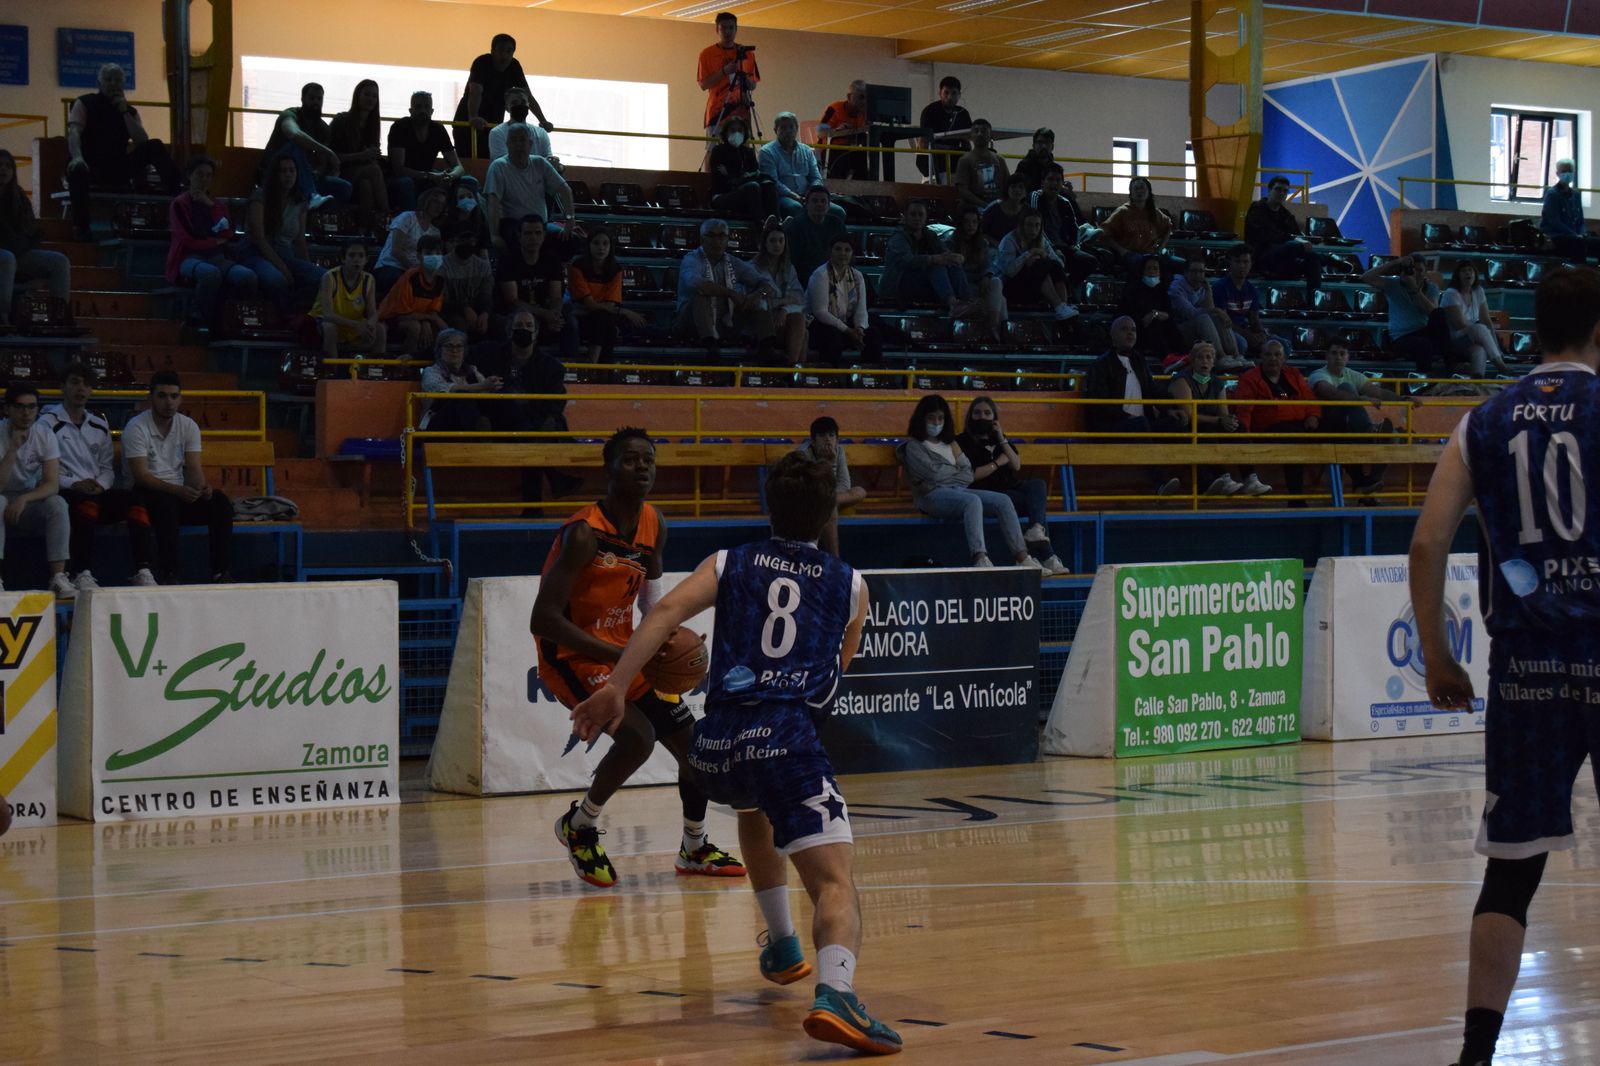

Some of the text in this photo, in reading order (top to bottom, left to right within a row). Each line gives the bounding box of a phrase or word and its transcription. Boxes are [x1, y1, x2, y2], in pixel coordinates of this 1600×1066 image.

[1512, 402, 1576, 422] FORTU
[1508, 429, 1586, 545] 10
[753, 553, 823, 578] INGELMO
[1544, 556, 1600, 579] PIXE
[863, 595, 1035, 627] ALACIO DEL DUERO
[1121, 571, 1297, 628] Supermercados
[761, 576, 801, 658] 8
[853, 631, 930, 659] AMORA
[1128, 622, 1290, 678] San Pablo
[105, 642, 392, 770] Studios
[831, 688, 920, 716] estaurante
[1135, 697, 1164, 717] Calle
[1167, 694, 1188, 714] San
[1192, 691, 1227, 713] Pablo,
[1230, 689, 1237, 709] 8
[1248, 688, 1286, 707] Zamora
[1153, 724, 1174, 744] 980
[1177, 722, 1198, 742] 092
[1200, 720, 1221, 740] 270
[1232, 717, 1252, 737] 622
[1256, 715, 1275, 735] 406
[1277, 713, 1296, 733] 712
[302, 743, 389, 767] Zamora
[745, 744, 788, 762] Reina
[102, 779, 390, 815] CENTRO DE ENSEÑANZA
